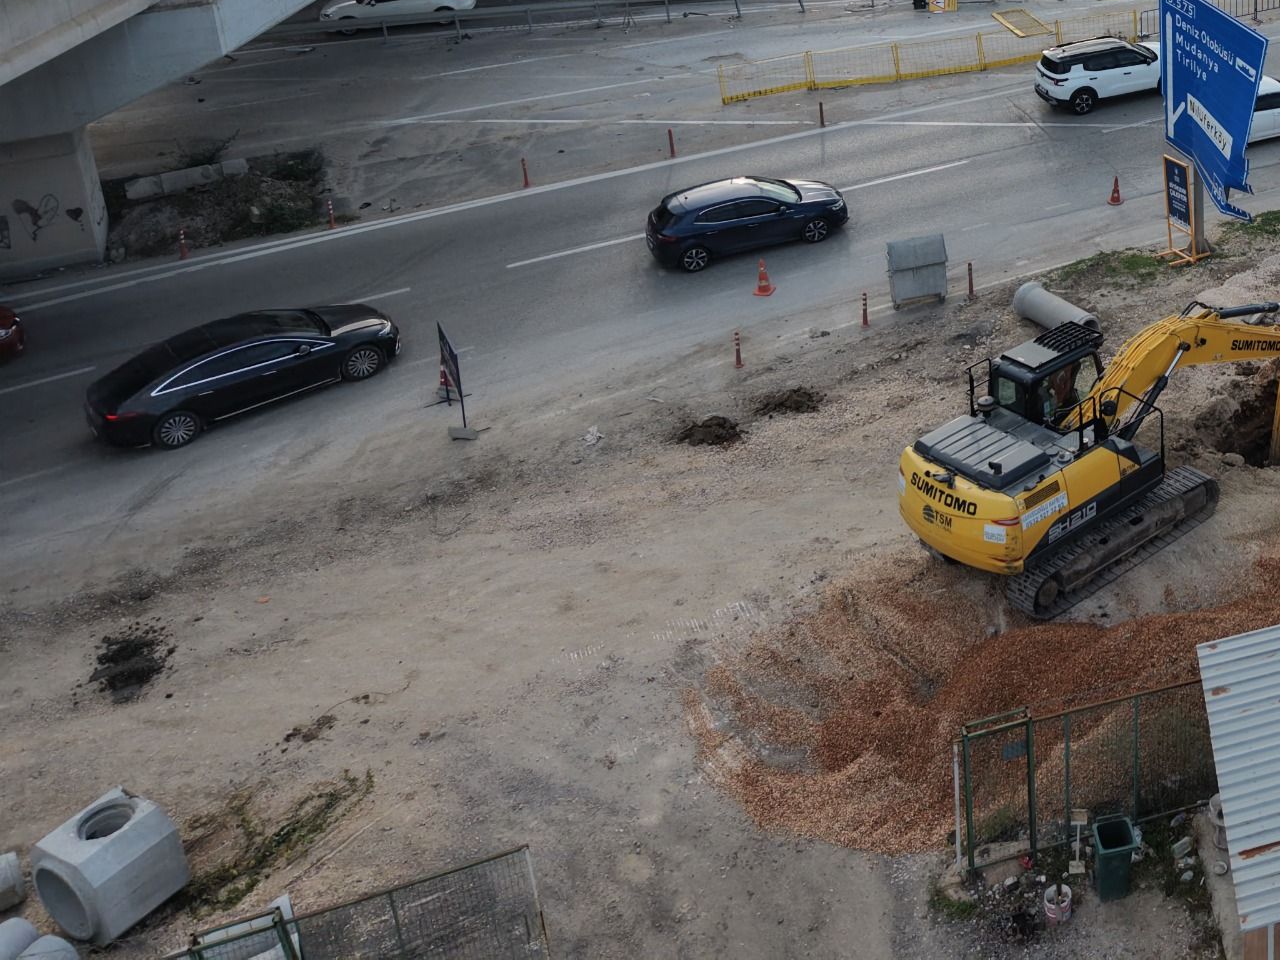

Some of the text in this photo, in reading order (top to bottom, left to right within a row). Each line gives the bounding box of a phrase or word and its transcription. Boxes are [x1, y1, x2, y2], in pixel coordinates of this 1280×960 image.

[1175, 14, 1234, 65] Deniz Otobüsü
[1175, 32, 1219, 73] Mudanya
[1176, 49, 1207, 81] Tirilye
[911, 472, 977, 516] SUMITOMO
[934, 510, 952, 528] TSM
